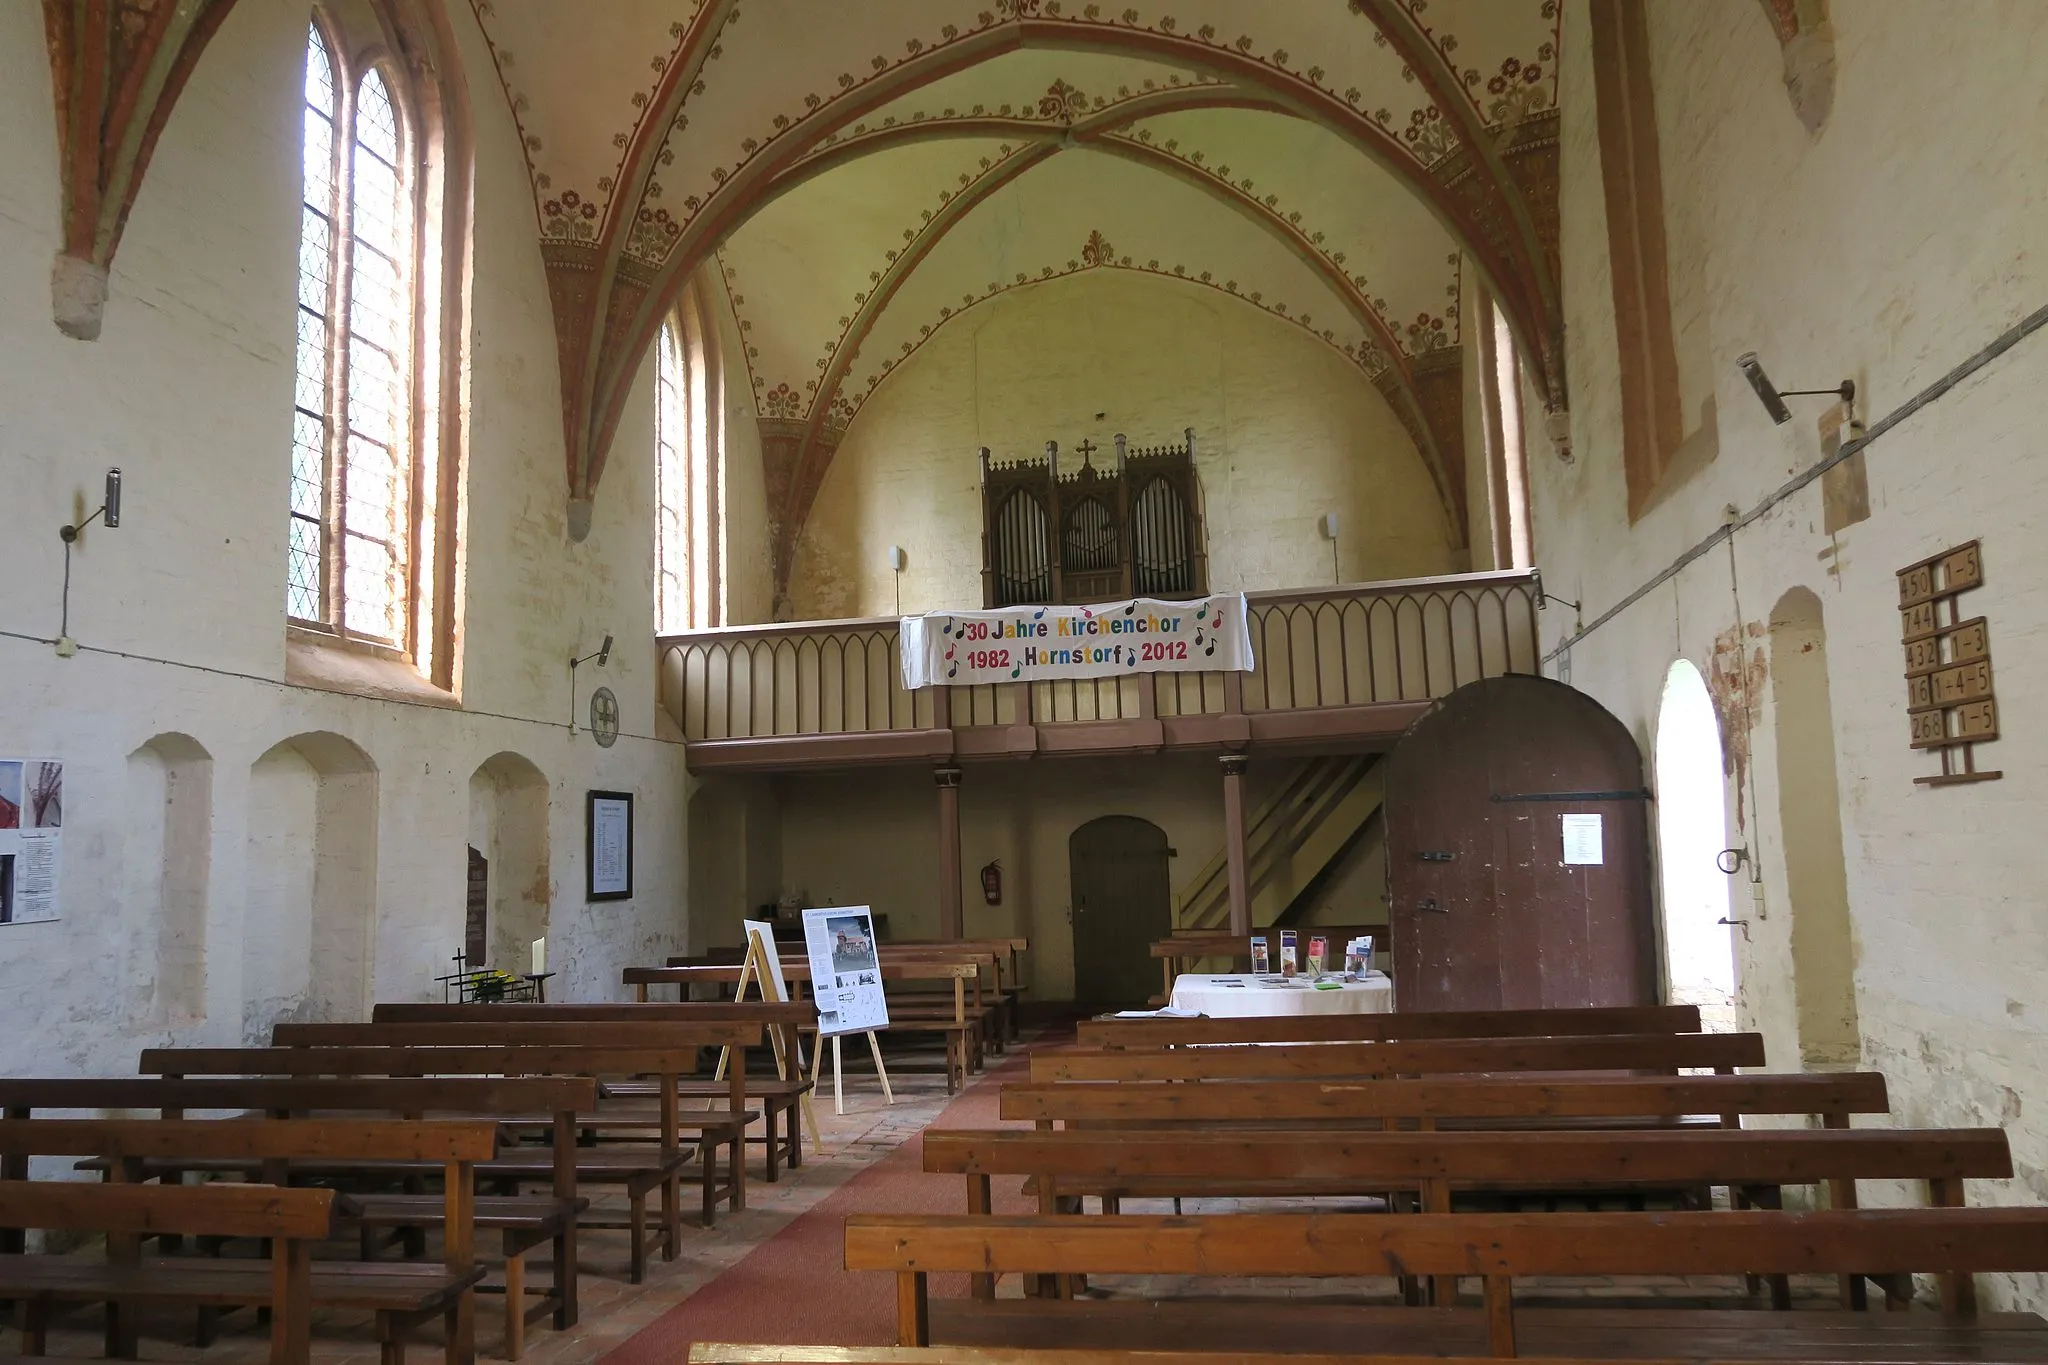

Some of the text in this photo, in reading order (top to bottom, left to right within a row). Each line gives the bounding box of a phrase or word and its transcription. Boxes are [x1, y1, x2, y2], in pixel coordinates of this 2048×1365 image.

[1900, 571, 1928, 599] 450
[966, 613, 1181, 641] 30 Jahre Kirchenchor
[1904, 605, 1931, 634] 744
[967, 641, 1188, 669] 1982 Hornstorf 2012
[1907, 641, 1935, 669] 432
[1910, 679, 1928, 704] 16
[1912, 712, 1941, 739] 268
